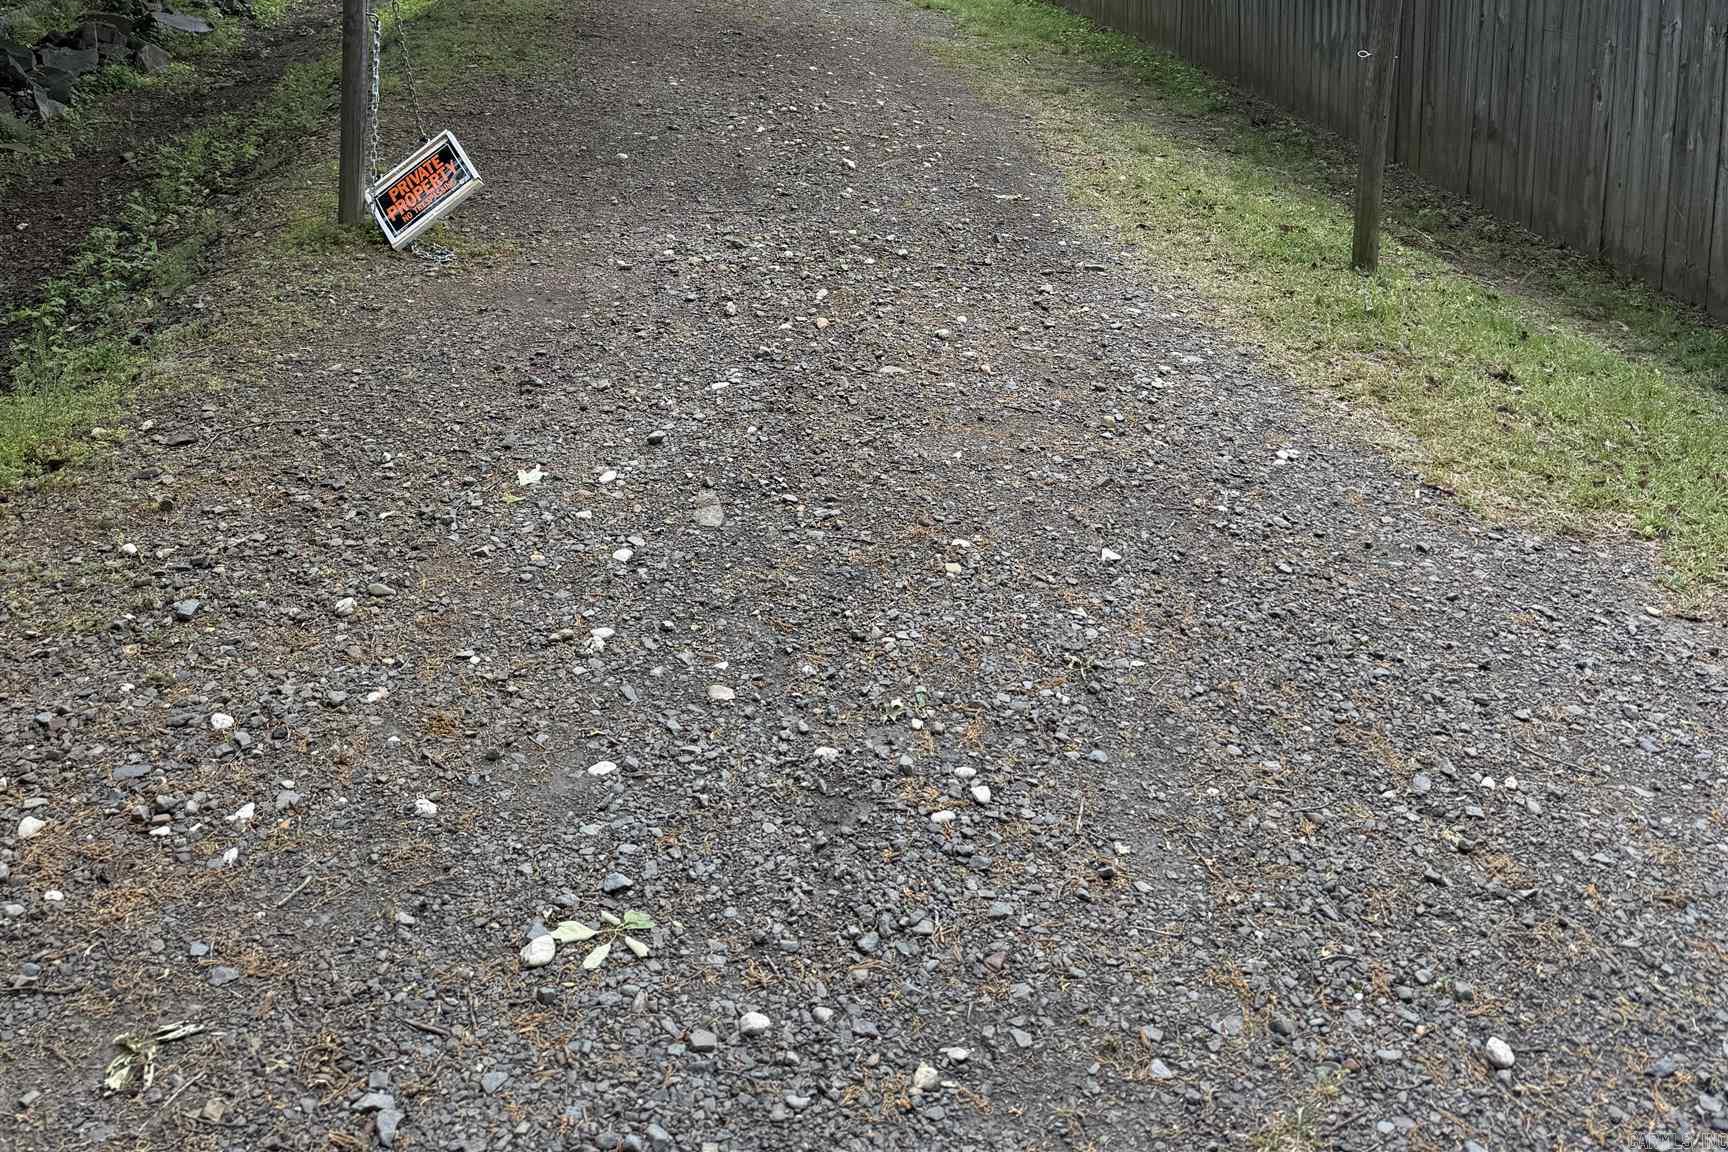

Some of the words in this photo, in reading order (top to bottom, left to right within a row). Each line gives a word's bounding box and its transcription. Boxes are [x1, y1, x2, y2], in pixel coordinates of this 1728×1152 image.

[386, 159, 457, 222] PROPERTY
[387, 154, 444, 202] PRIVATE
[402, 211, 413, 223] NO
